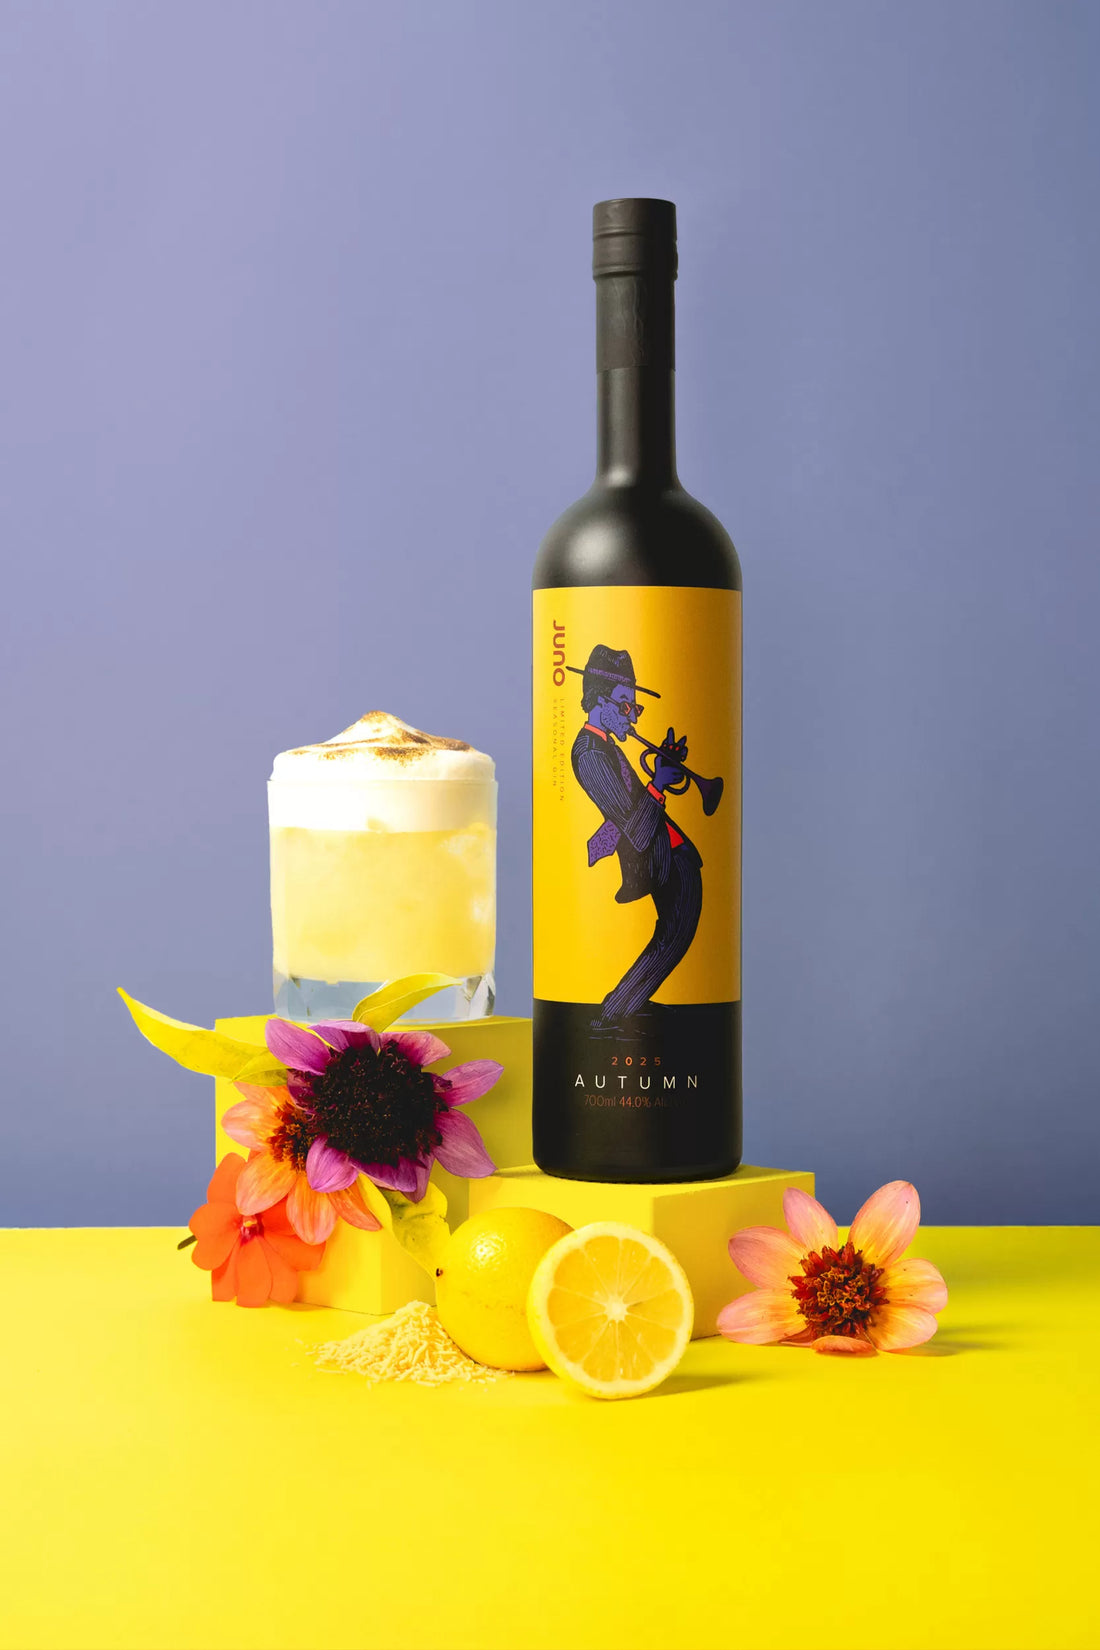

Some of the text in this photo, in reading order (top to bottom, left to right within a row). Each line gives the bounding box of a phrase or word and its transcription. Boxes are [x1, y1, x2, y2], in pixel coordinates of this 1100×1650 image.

[553, 619, 566, 687] JUNO
[611, 1056, 661, 1066] 2025
[574, 1074, 698, 1090] AUTUMN
[584, 1095, 616, 1107] 700ml
[619, 1096, 651, 1108] 44.0%
